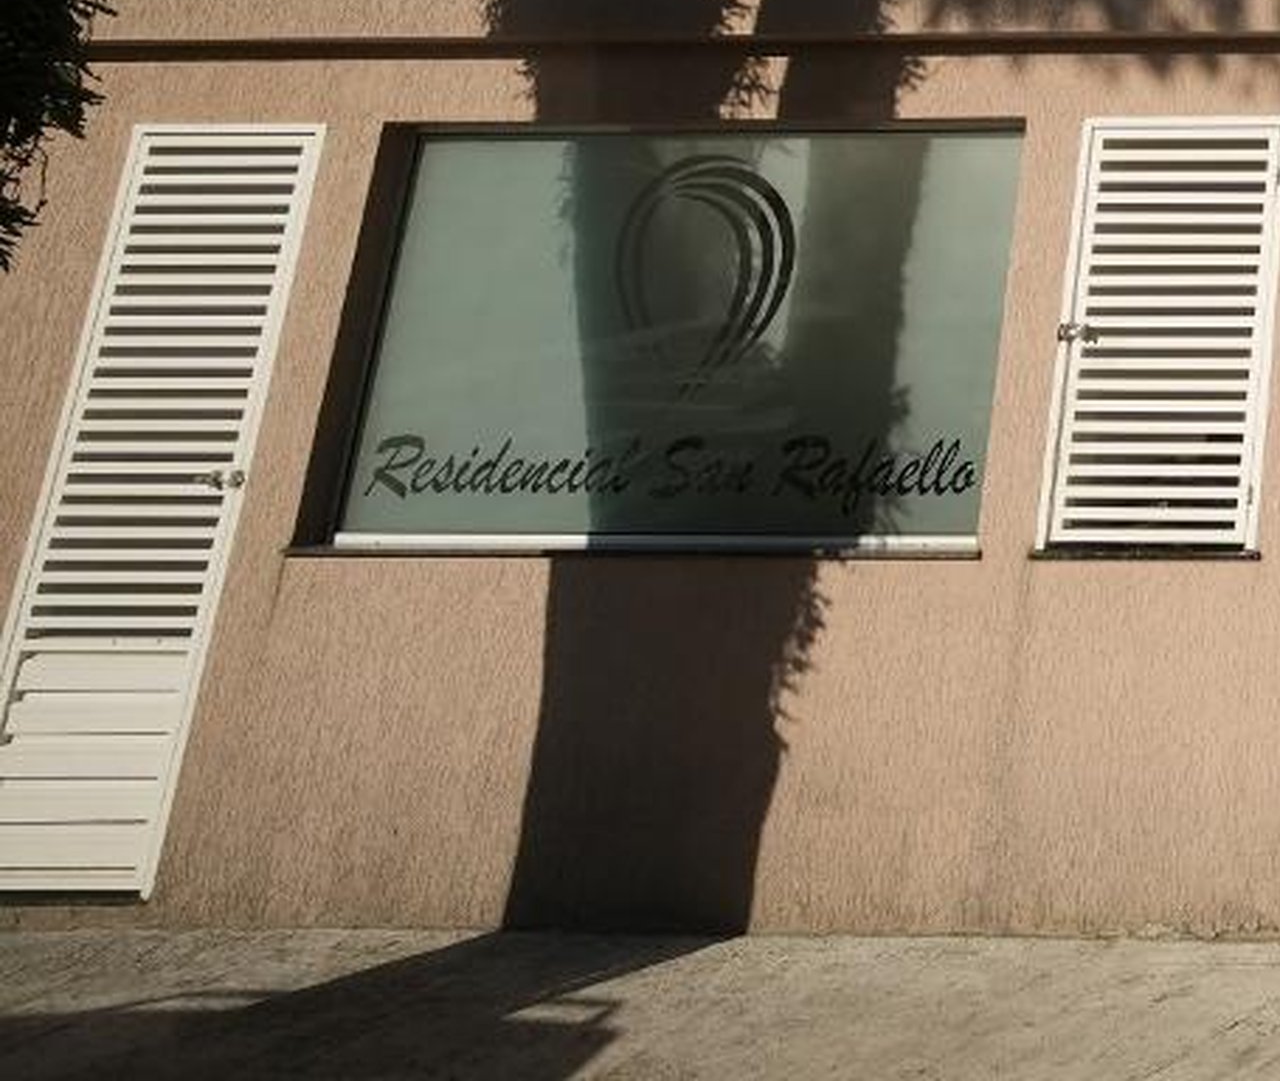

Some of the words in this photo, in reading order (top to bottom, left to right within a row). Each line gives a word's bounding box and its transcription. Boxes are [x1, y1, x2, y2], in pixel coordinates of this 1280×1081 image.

[363, 432, 638, 500] Residencial
[648, 434, 755, 499] San
[767, 434, 978, 517] Rafaello
